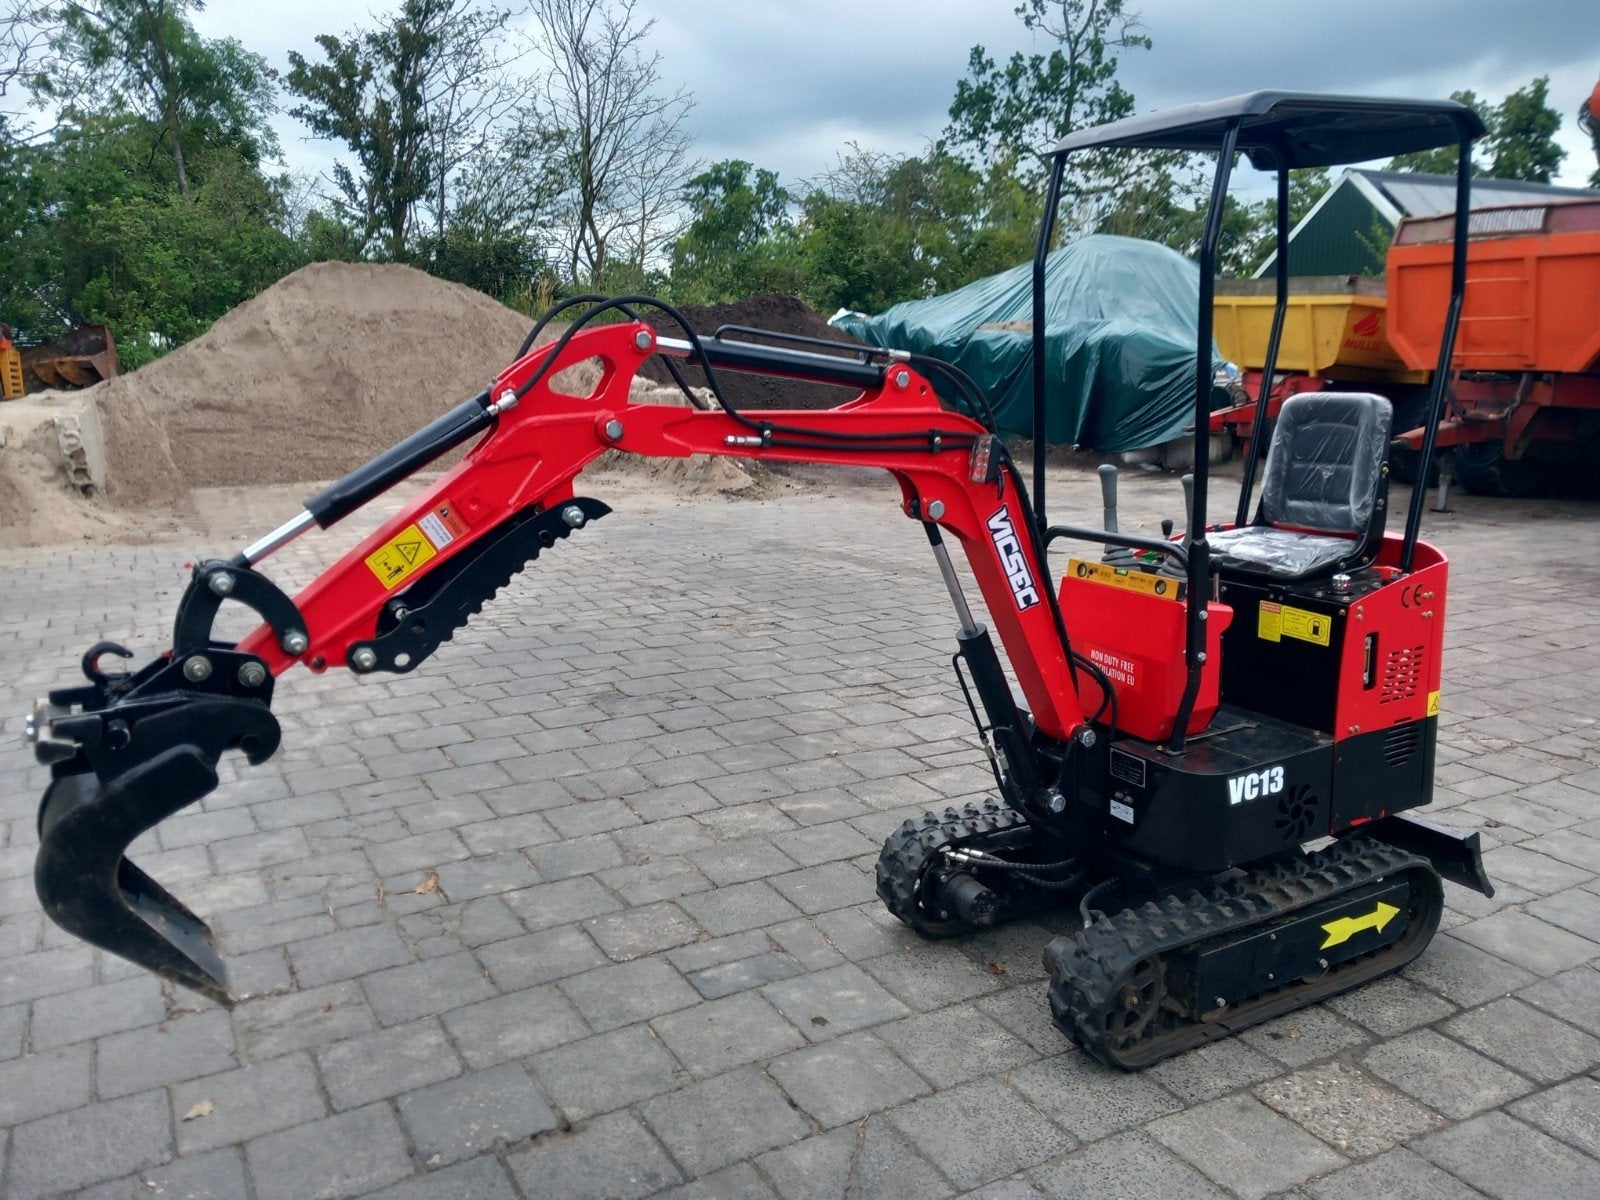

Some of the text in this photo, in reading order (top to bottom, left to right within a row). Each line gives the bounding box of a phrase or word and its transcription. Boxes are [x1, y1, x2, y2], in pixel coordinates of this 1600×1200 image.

[1344, 338, 1382, 351] MULLIE
[986, 504, 1040, 611] VICSEC
[1402, 584, 1422, 608] CE
[1091, 649, 1134, 674] NON DUTY FREE
[1127, 674, 1134, 686] EU
[1229, 766, 1284, 805] VC13
